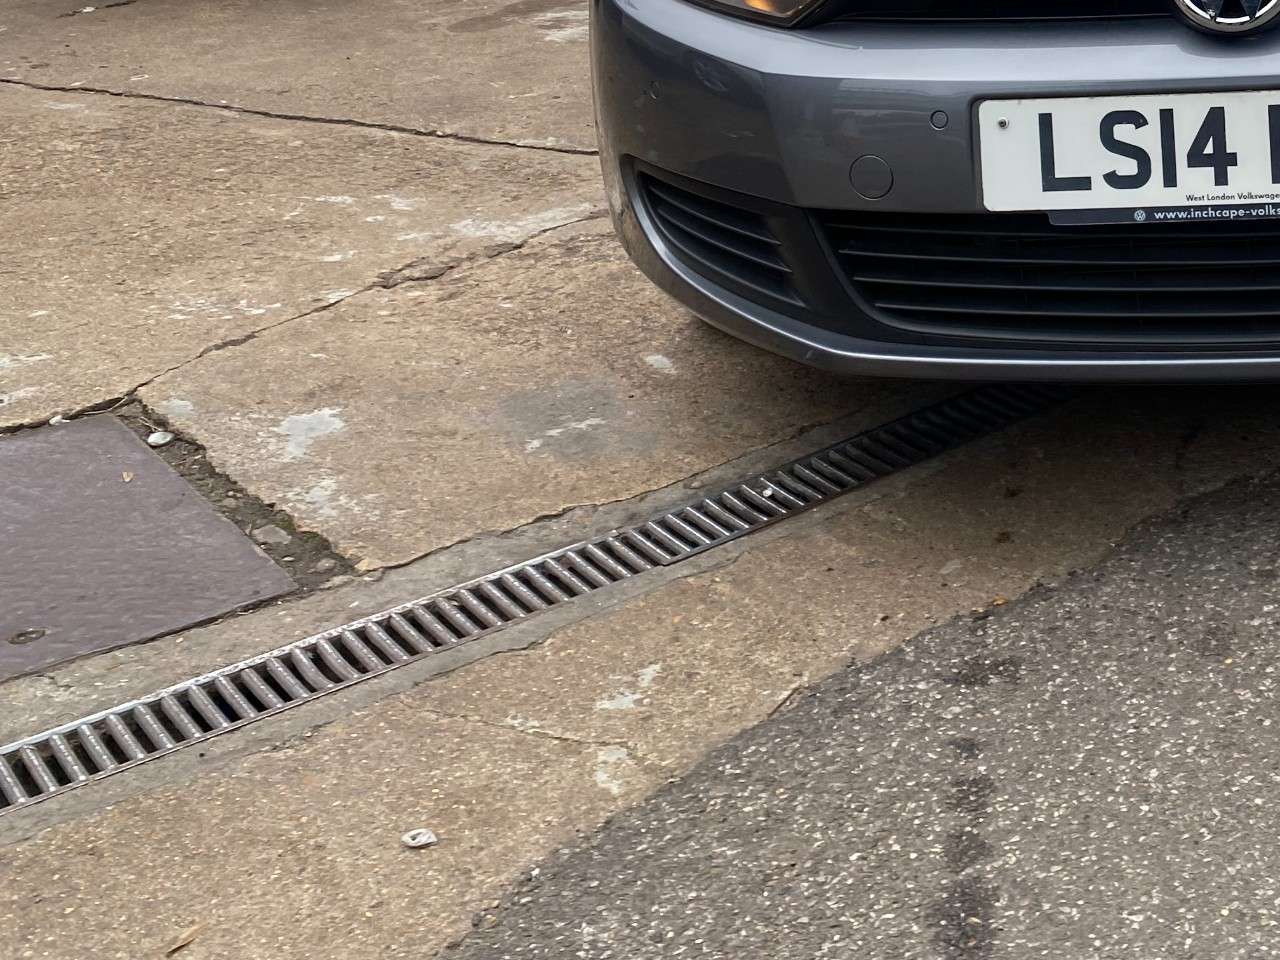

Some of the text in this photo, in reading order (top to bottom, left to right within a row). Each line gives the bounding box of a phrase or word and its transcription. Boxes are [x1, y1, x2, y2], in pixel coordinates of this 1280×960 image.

[1037, 106, 1238, 193] LS14
[1186, 193, 1205, 202] West
[1207, 192, 1235, 201] London
